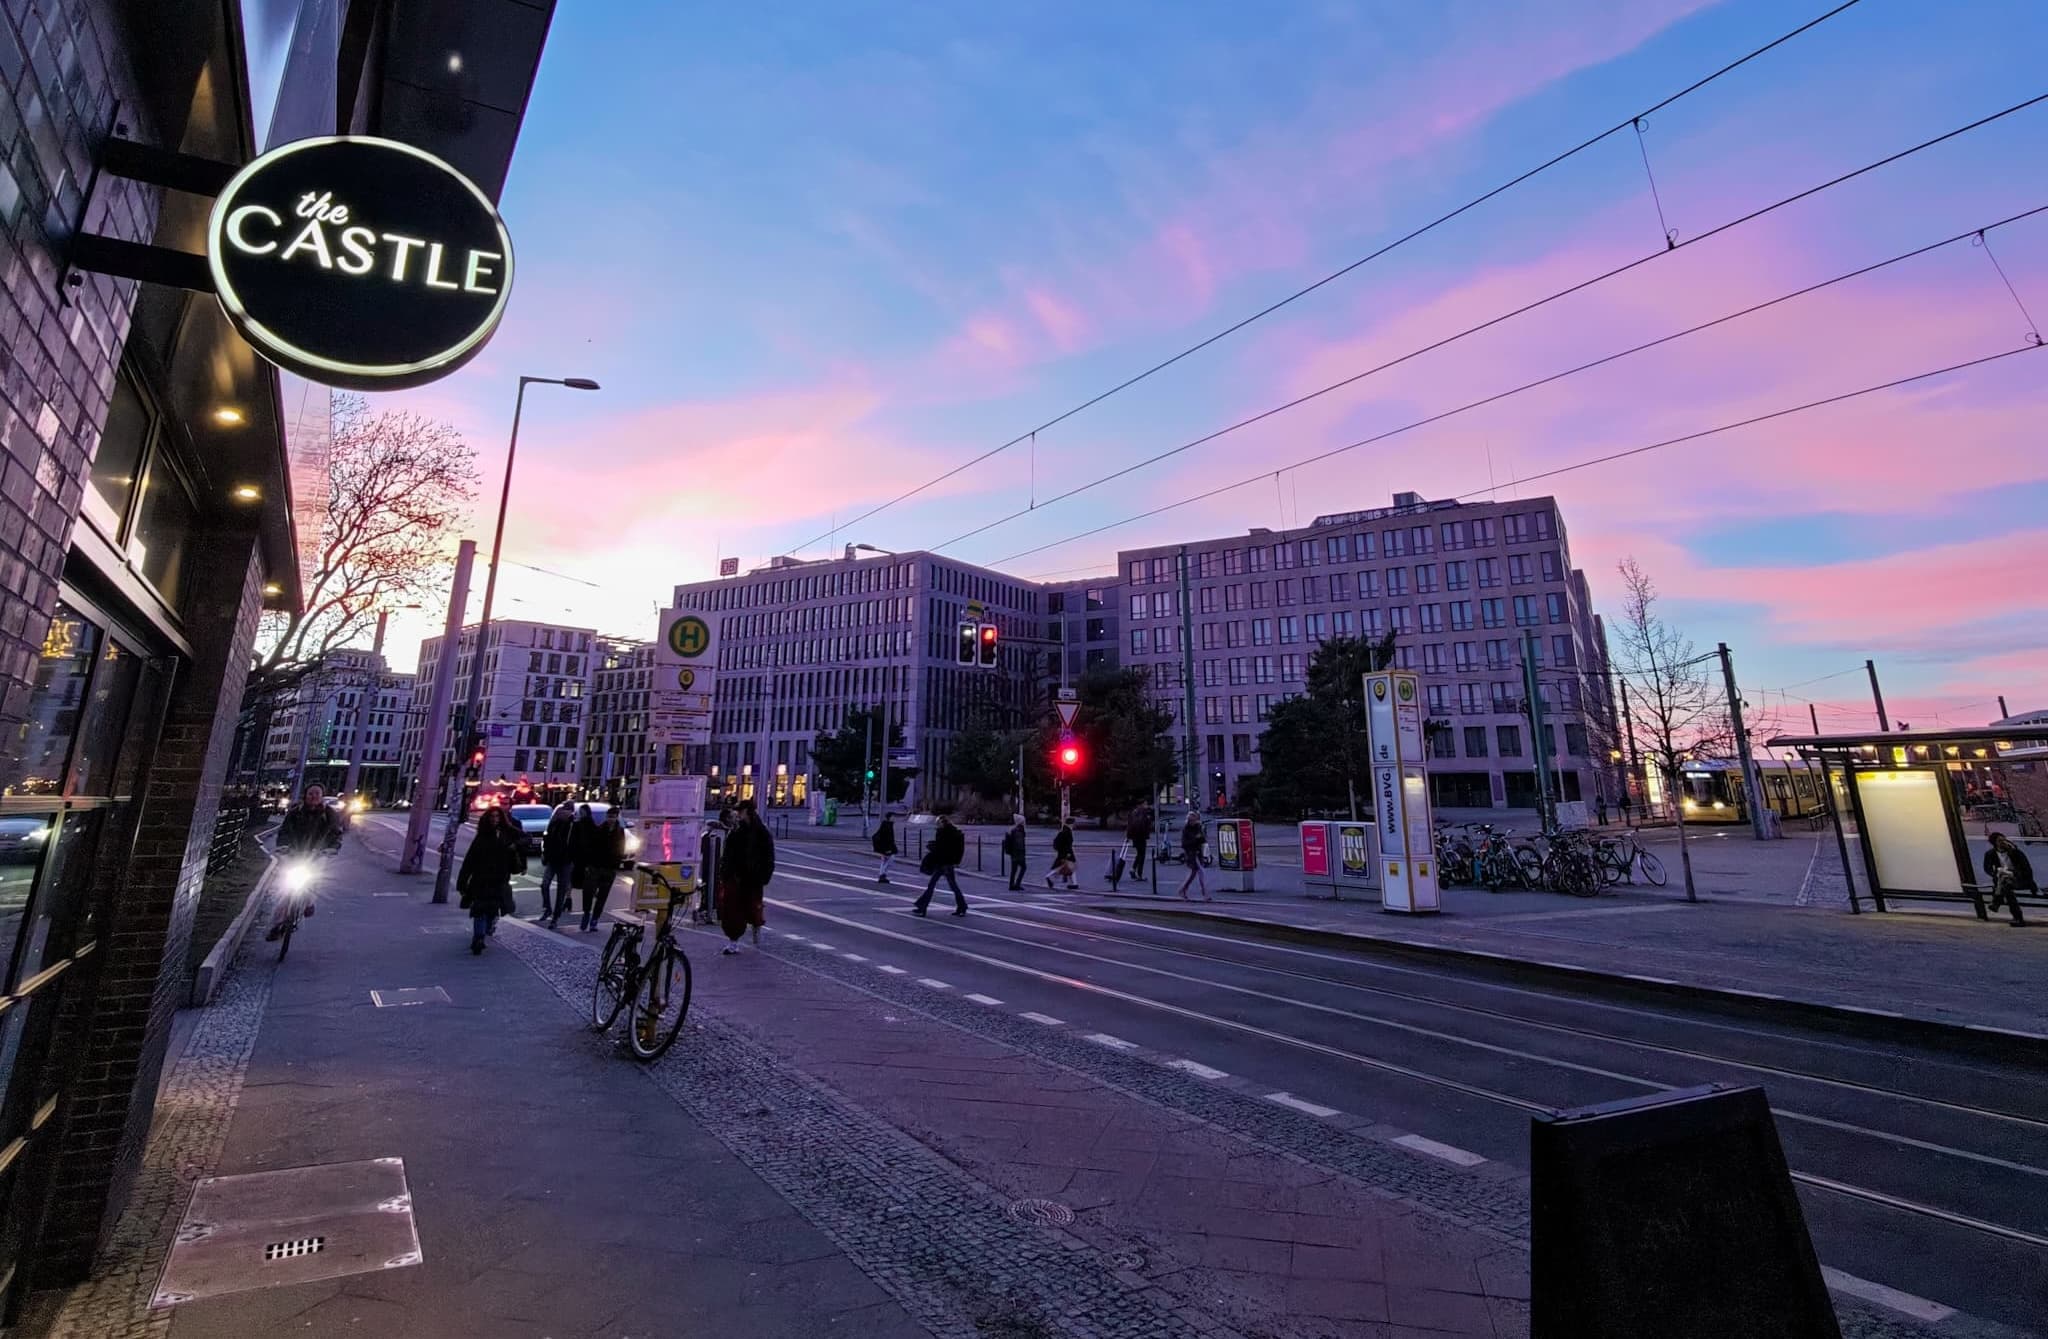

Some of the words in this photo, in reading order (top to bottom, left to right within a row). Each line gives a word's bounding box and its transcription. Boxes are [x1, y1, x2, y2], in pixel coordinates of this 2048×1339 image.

[296, 191, 350, 225] the
[226, 204, 502, 295] CASTLE
[680, 626, 699, 648] H
